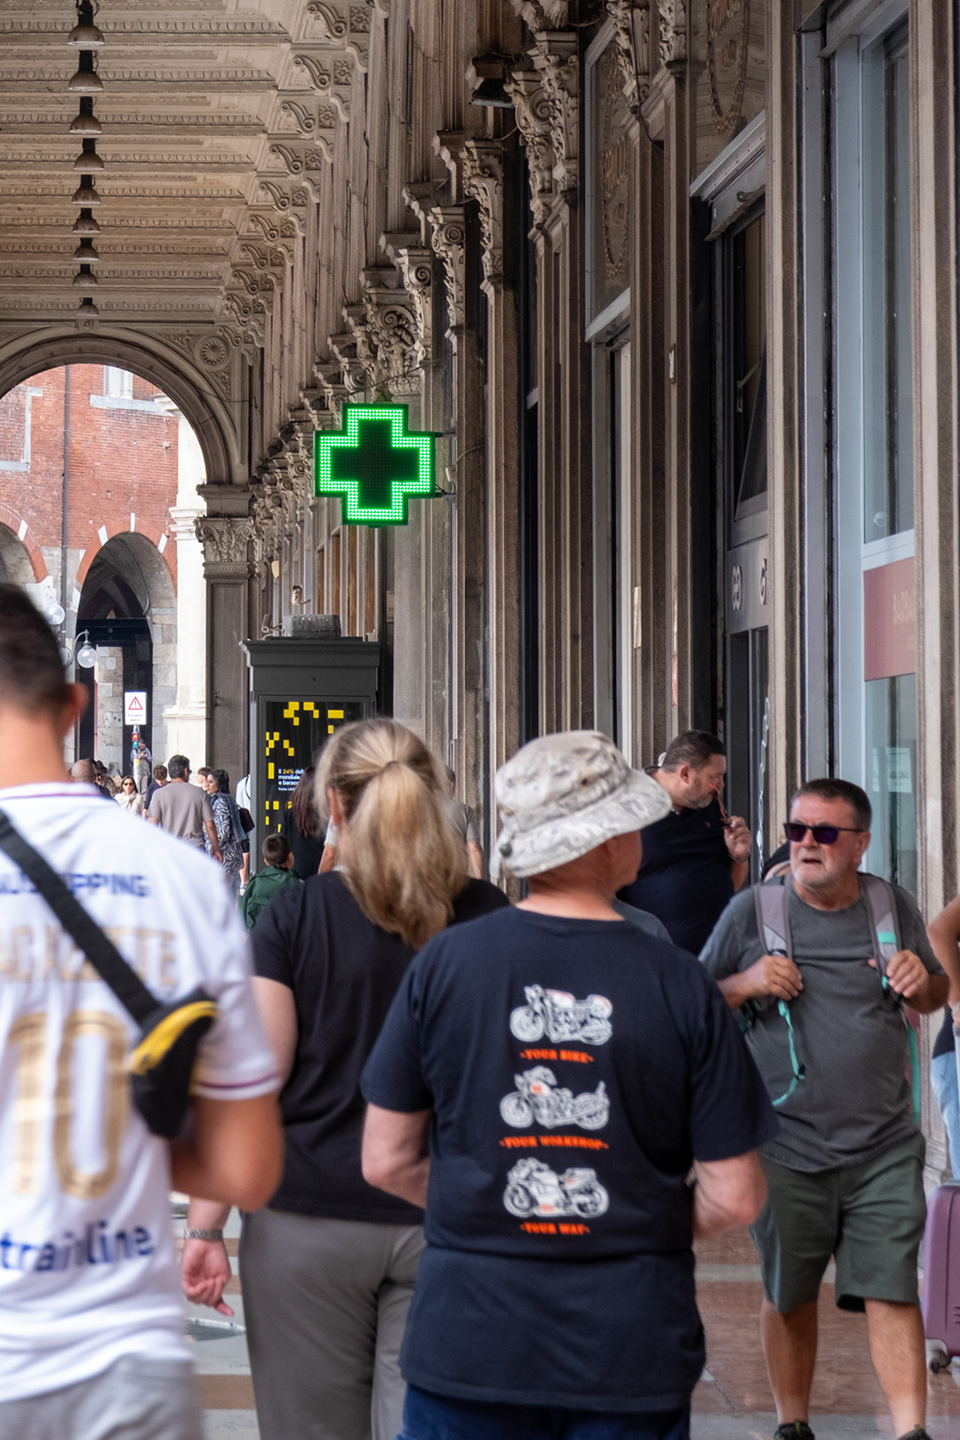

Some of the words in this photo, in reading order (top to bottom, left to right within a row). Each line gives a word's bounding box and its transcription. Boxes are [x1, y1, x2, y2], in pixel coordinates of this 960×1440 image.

[525, 1048, 558, 1061] YOUR
[559, 1050, 589, 1064] BIKE
[6, 1010, 128, 1201] 10
[503, 1135, 538, 1149] YOUR
[539, 1135, 603, 1150] WORKSHOP
[524, 1222, 558, 1235] YOUR
[558, 1222, 585, 1235] WAY
